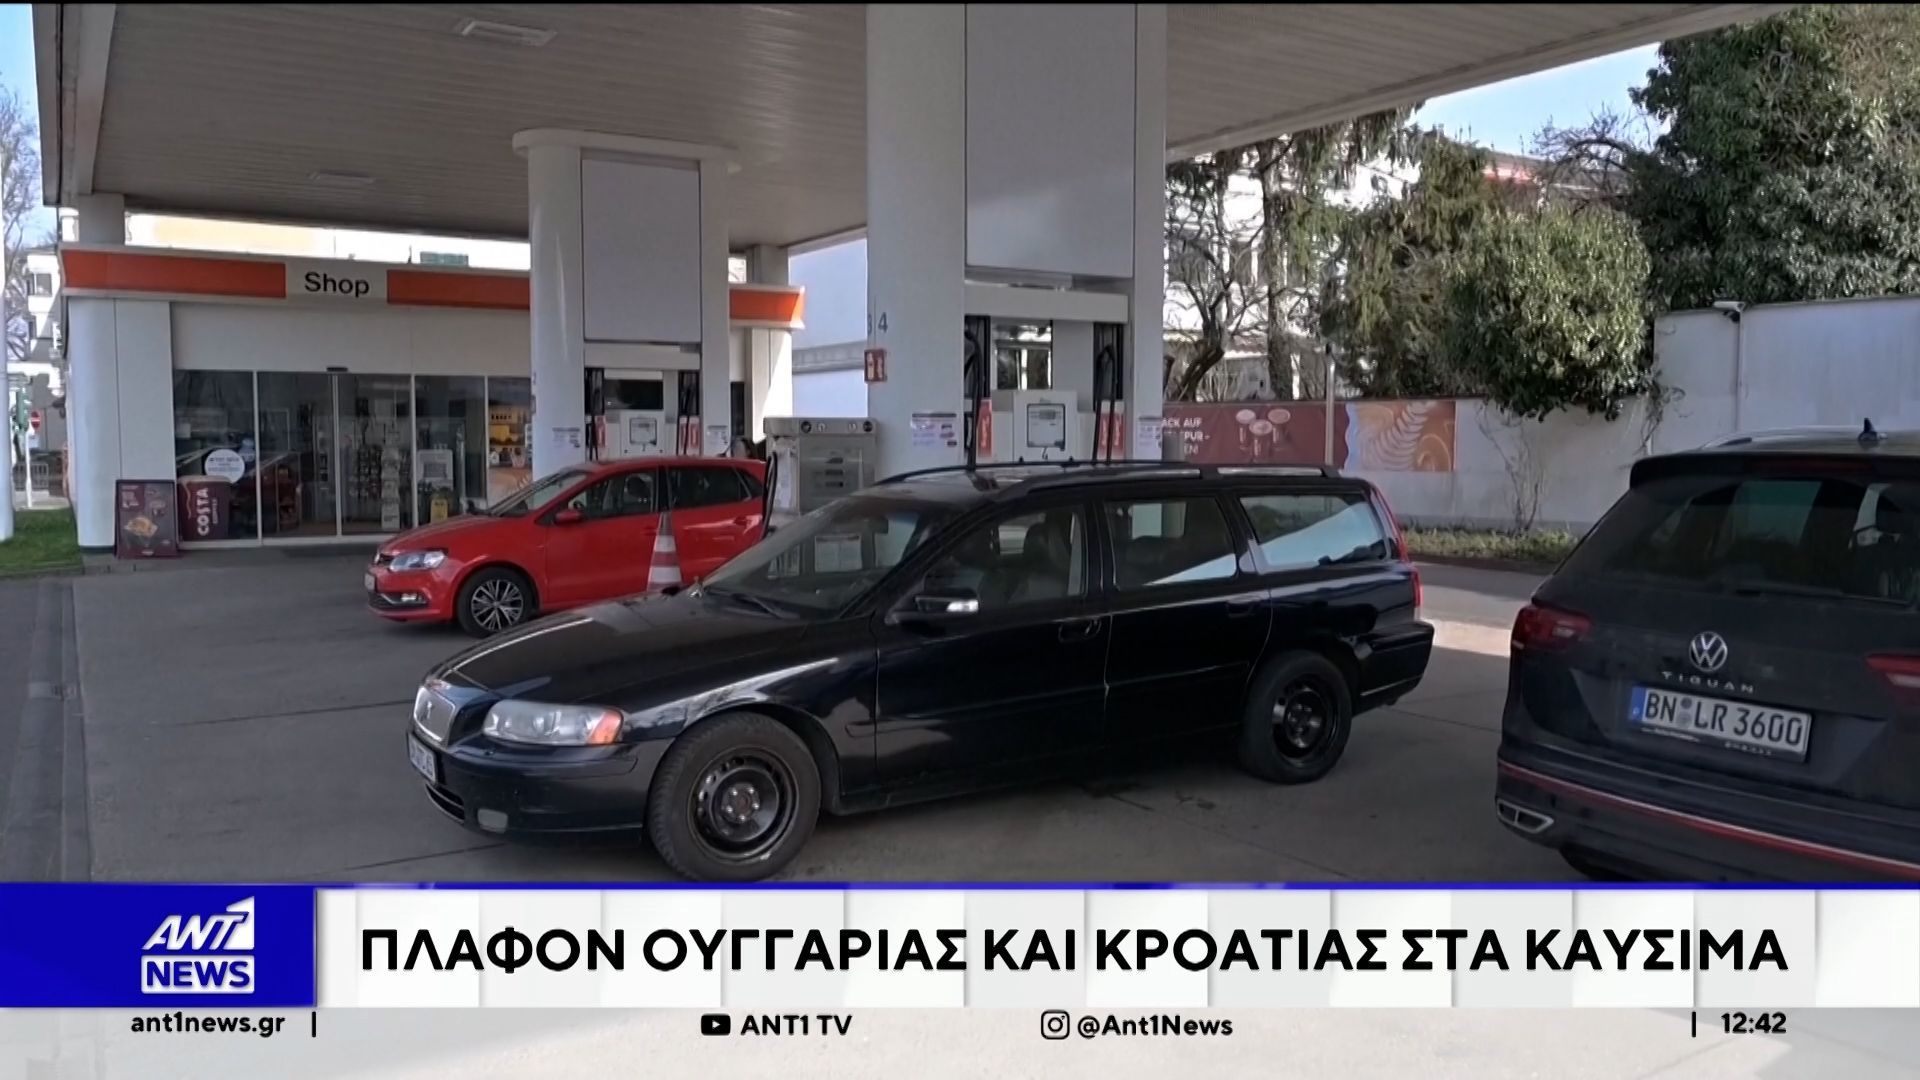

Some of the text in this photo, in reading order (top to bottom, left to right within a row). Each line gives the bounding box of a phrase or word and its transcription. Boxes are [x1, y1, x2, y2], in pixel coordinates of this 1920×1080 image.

[305, 271, 369, 298] Shop
[878, 311, 888, 333] 4
[1183, 417, 1202, 428] AUF
[196, 487, 210, 536] COSTA
[1661, 671, 1754, 693] TIGUAN
[1645, 693, 1678, 723] BN
[1694, 701, 1728, 732] LR
[1733, 707, 1803, 746] 3600
